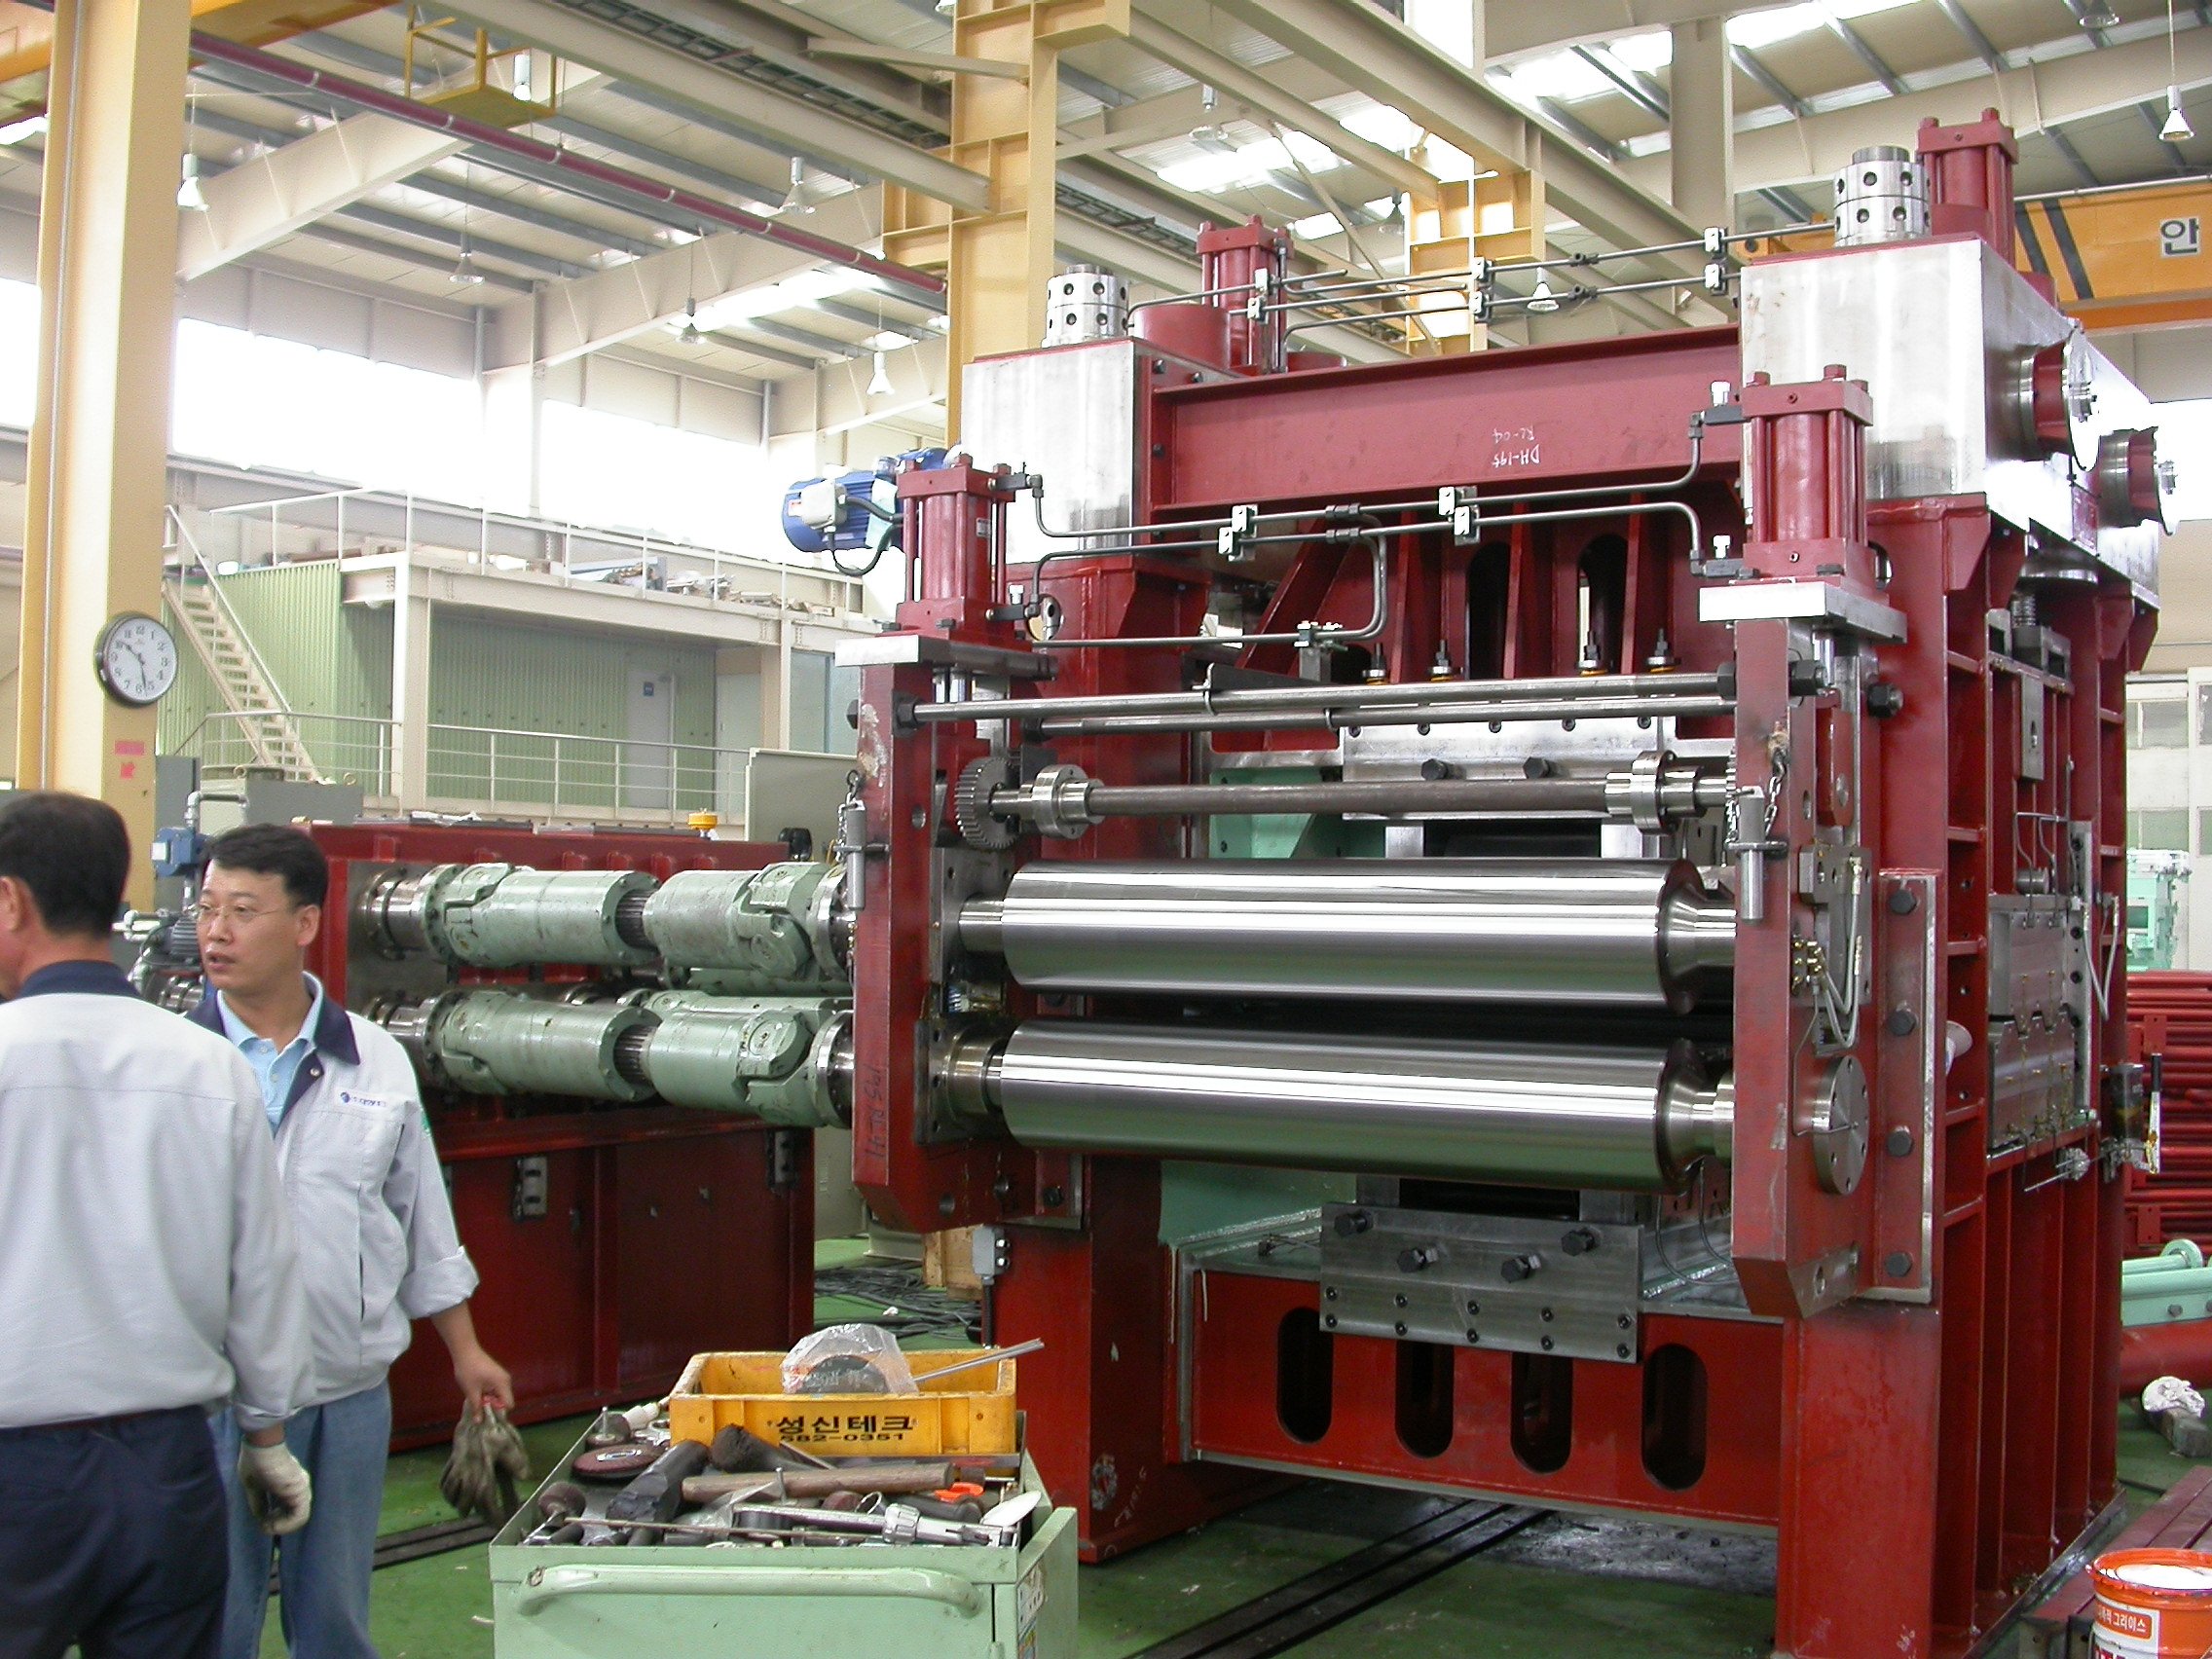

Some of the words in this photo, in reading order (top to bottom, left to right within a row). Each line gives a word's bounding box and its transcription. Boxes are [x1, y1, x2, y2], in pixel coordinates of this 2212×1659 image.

[2160, 218, 2198, 255] 안
[1492, 444, 1539, 467] DH-195
[777, 1415, 913, 1434] 성신테크
[780, 1433, 903, 1443] 582-0351
